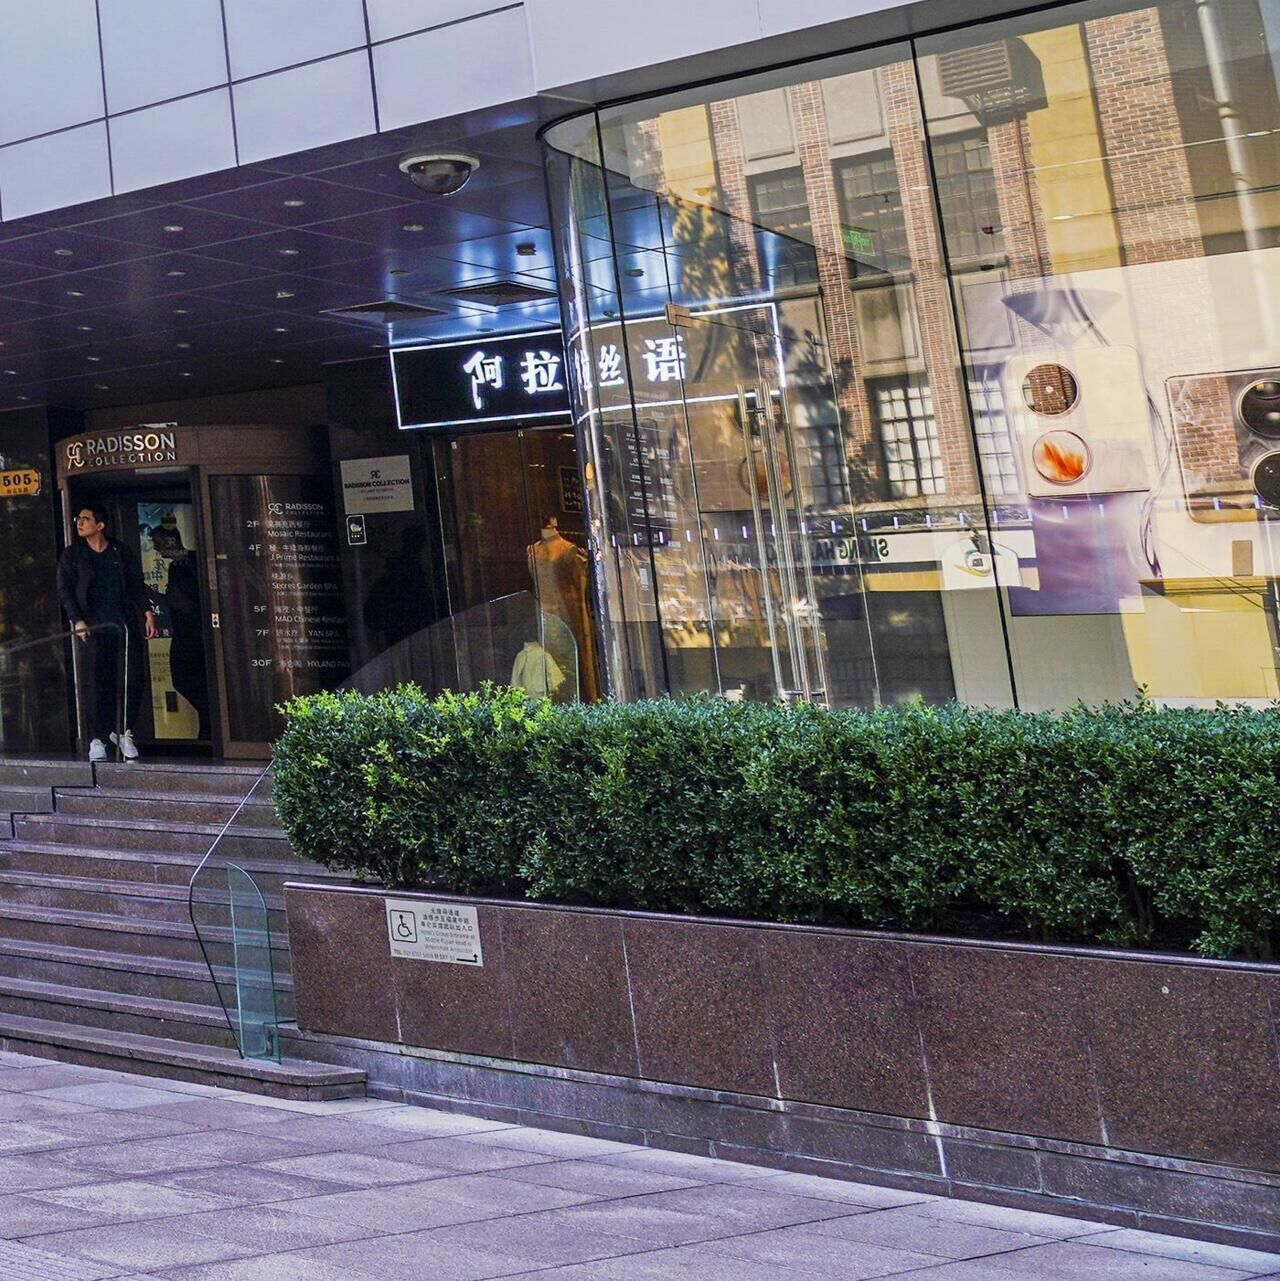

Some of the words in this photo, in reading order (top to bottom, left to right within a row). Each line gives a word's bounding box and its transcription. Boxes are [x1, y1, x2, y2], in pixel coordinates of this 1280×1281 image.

[86, 432, 176, 456] RADISSON
[88, 451, 176, 468] COLLECTION
[2, 474, 32, 487] 505
[371, 479, 410, 487] COLLECTION
[285, 503, 324, 511] RADISSON
[246, 520, 260, 528] 2F
[267, 530, 294, 538] Mosaic
[248, 543, 262, 551] 4F
[253, 605, 267, 613] 5F
[255, 629, 269, 637] 7F
[251, 659, 273, 667] 30F
